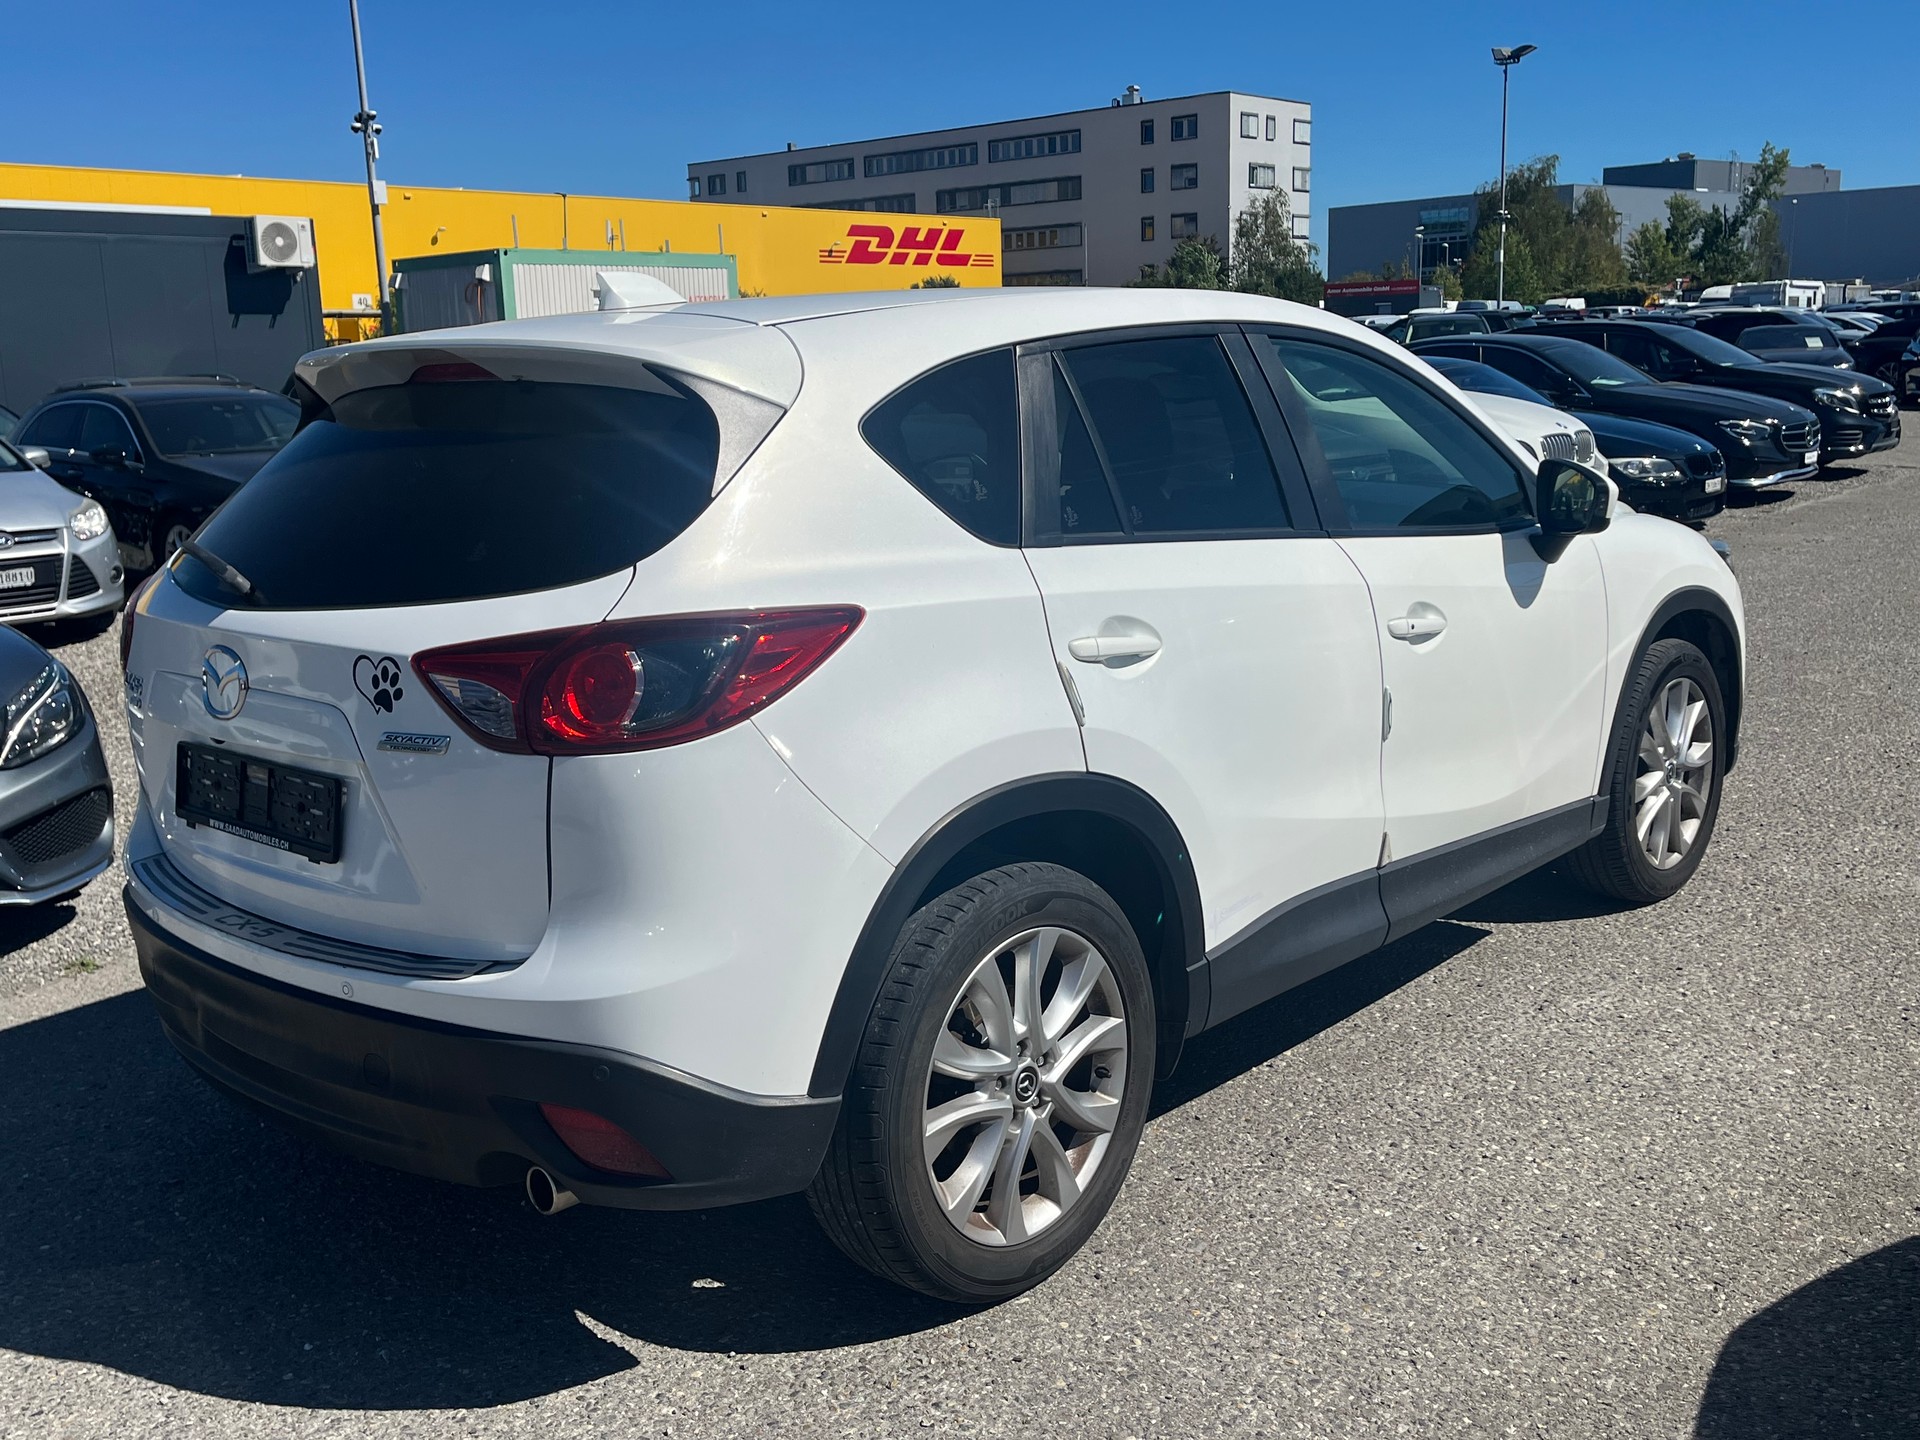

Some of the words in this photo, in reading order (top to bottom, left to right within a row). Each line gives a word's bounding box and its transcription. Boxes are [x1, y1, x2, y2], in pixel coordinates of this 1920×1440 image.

[845, 224, 972, 266] DHL
[384, 734, 441, 745] SKYACTIV
[209, 818, 289, 850] WWW.SAADAUTOMOBILES.CH
[214, 914, 284, 938] CX-5
